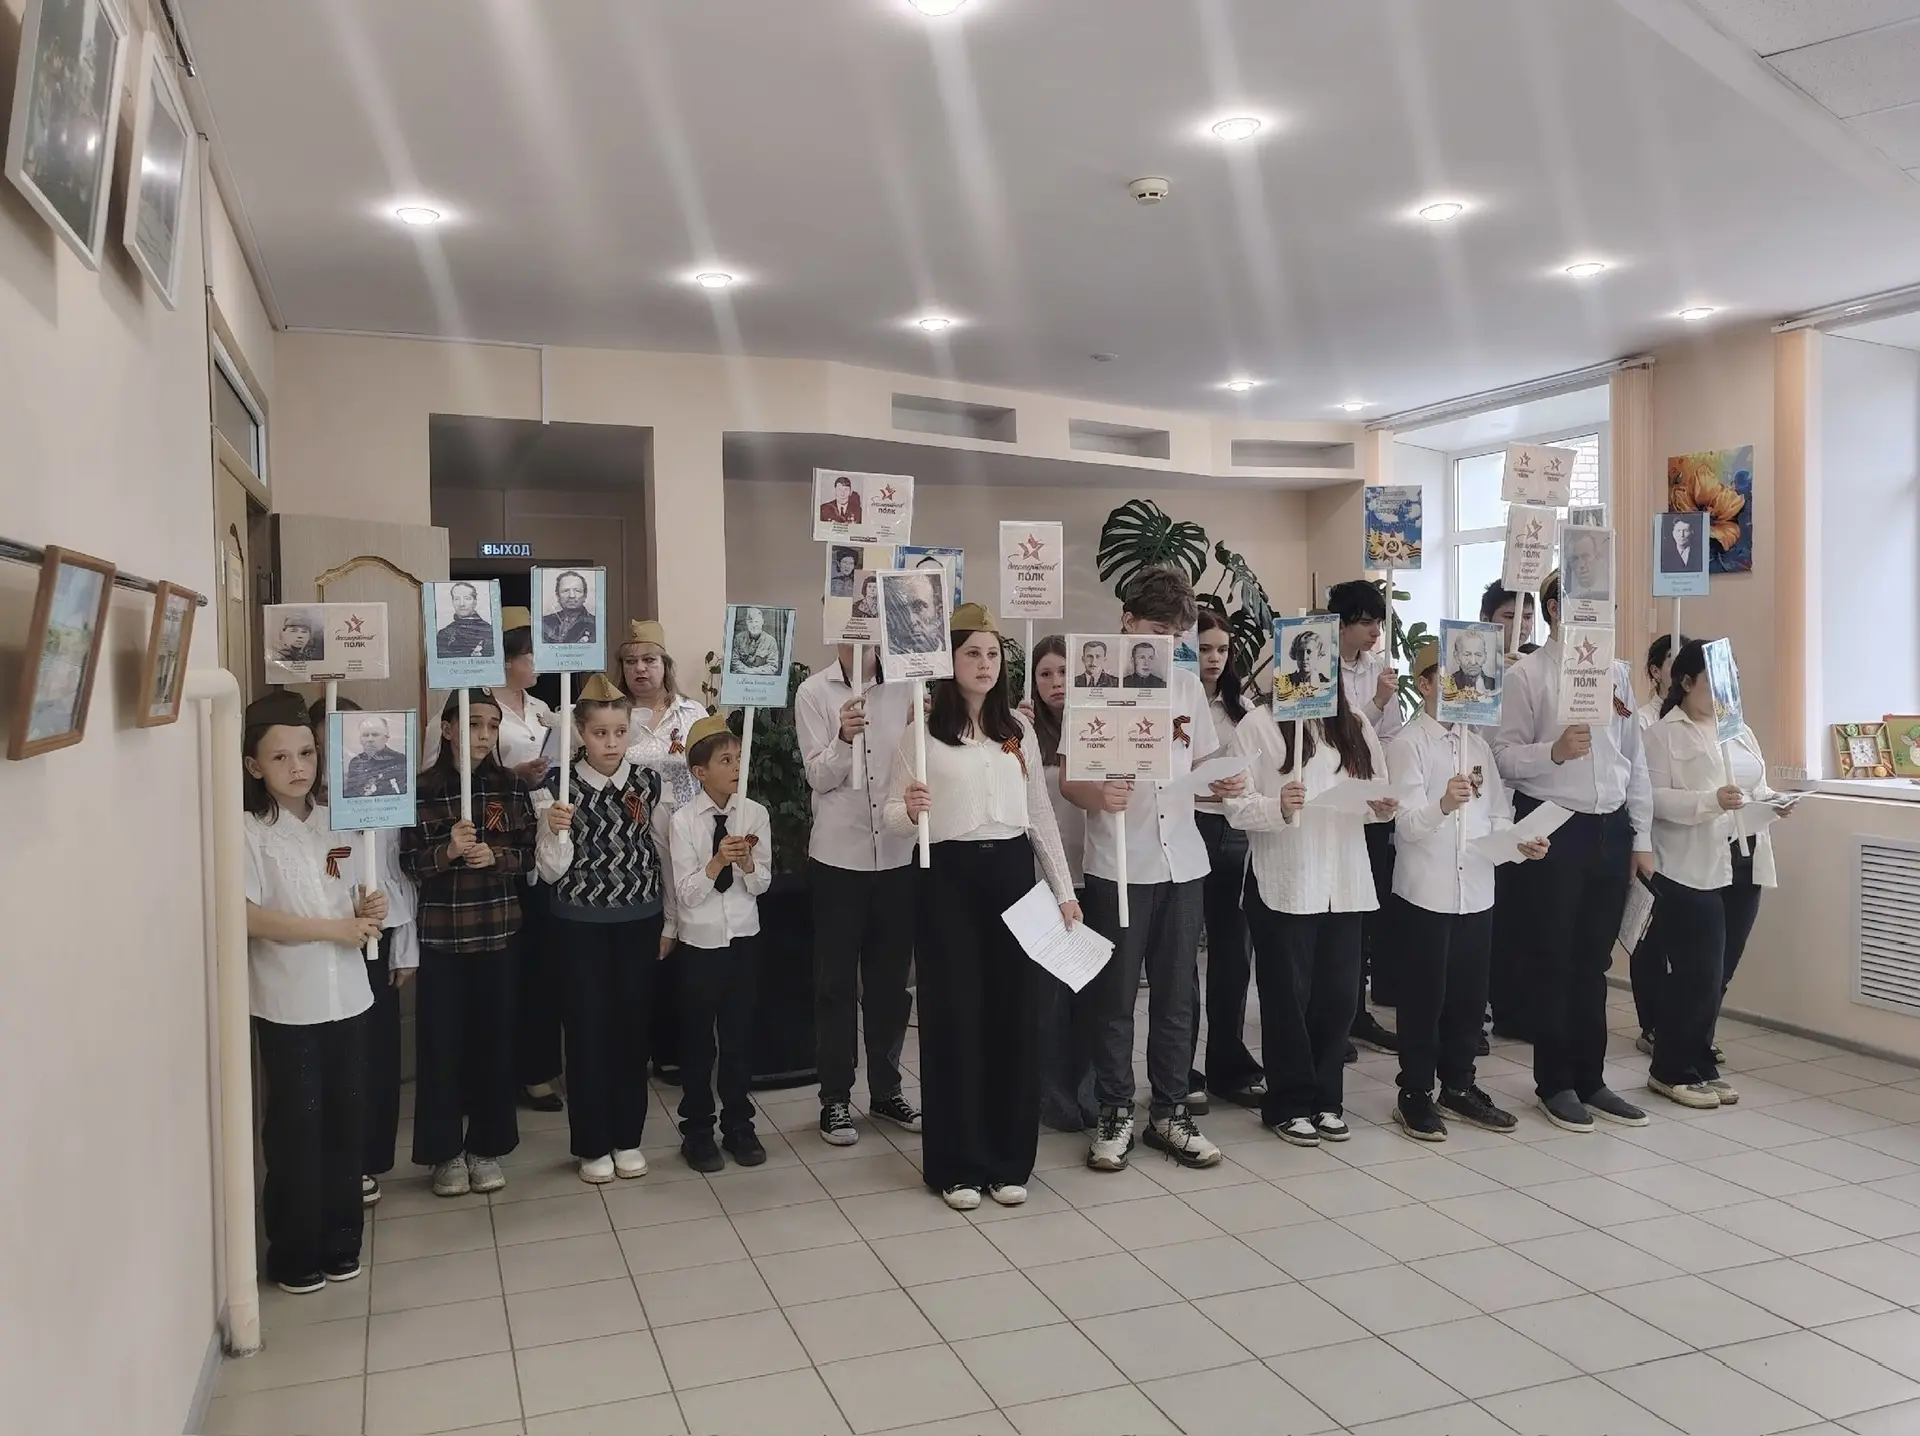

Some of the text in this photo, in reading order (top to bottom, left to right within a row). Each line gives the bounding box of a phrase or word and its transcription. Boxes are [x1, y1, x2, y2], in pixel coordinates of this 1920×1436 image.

[484, 544, 530, 556] ВЫХОД
[1018, 572, 1045, 582] ПОЛК
[1573, 677, 1598, 688] ПОЛК
